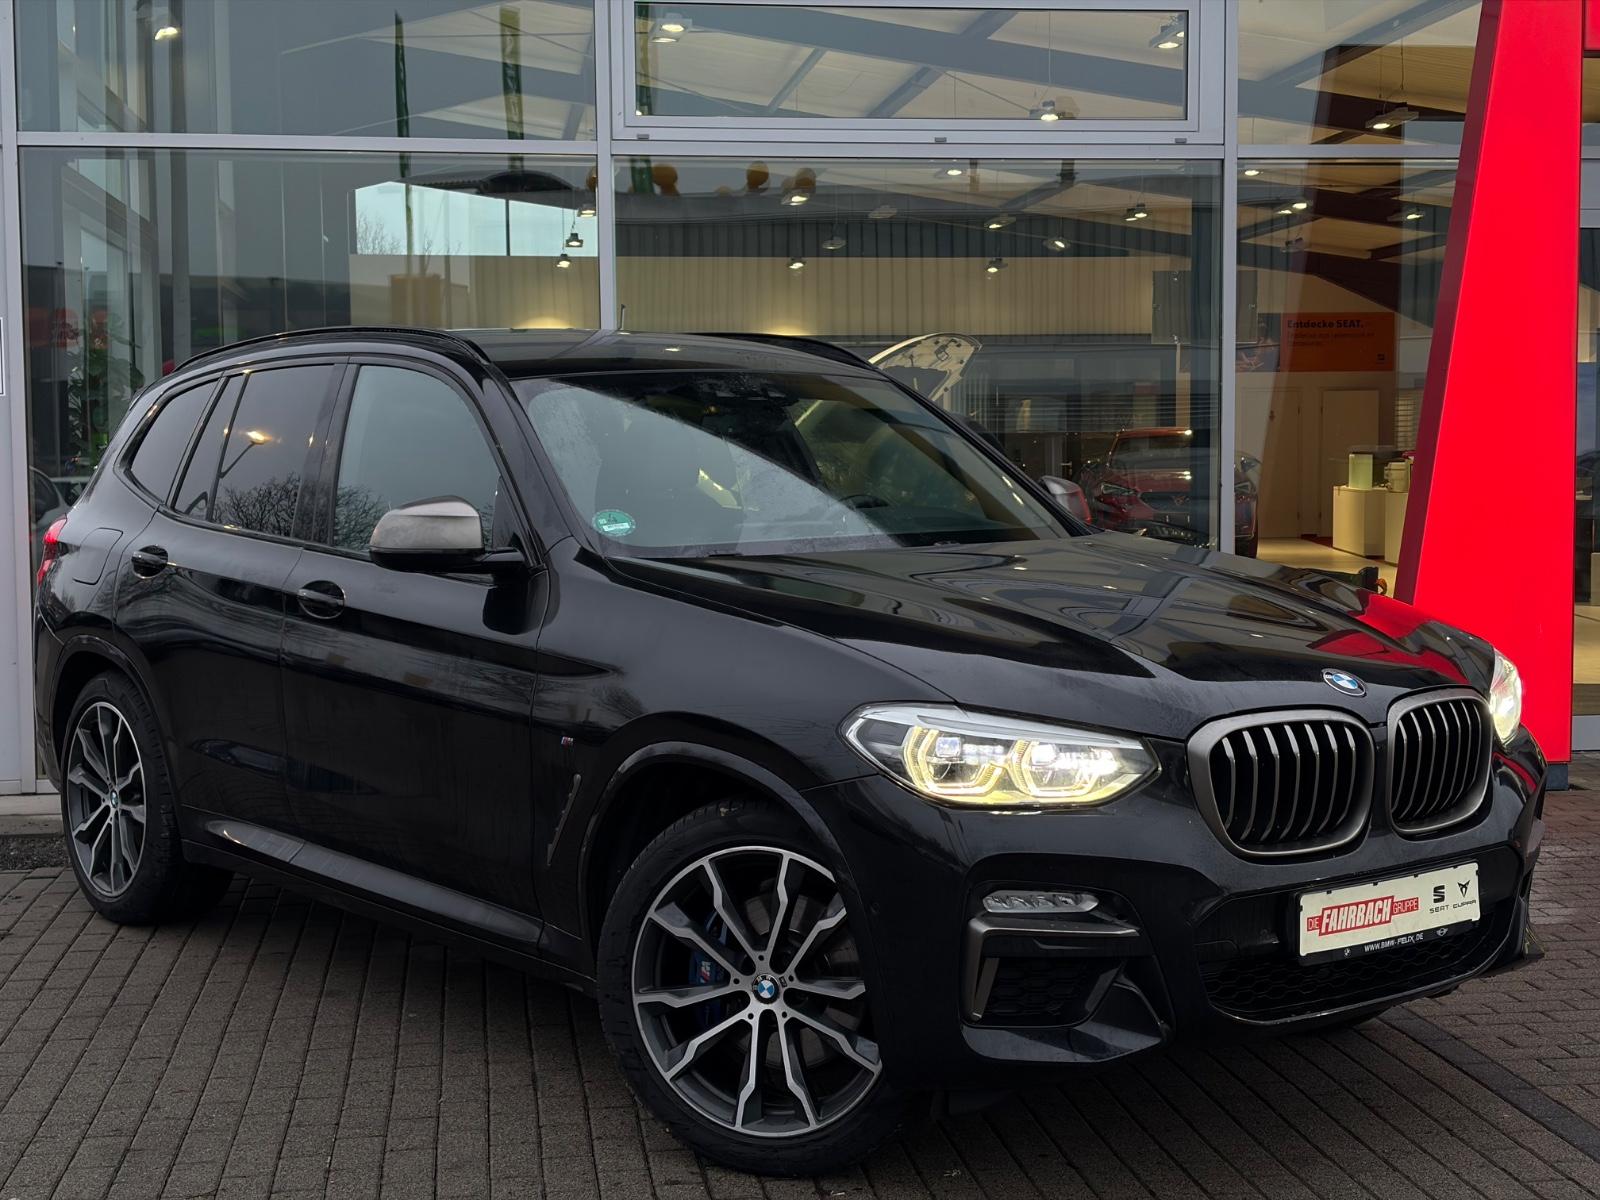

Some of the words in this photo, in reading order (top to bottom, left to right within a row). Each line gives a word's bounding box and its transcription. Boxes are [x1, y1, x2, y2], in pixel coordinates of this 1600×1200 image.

[1287, 319, 1334, 329] Entdecke
[1336, 319, 1364, 329] SEAT.
[1429, 904, 1450, 914] SEAT
[1308, 918, 1319, 930] DIE
[1321, 898, 1393, 934] FAHRBACH
[1393, 898, 1418, 914] GRUPPE
